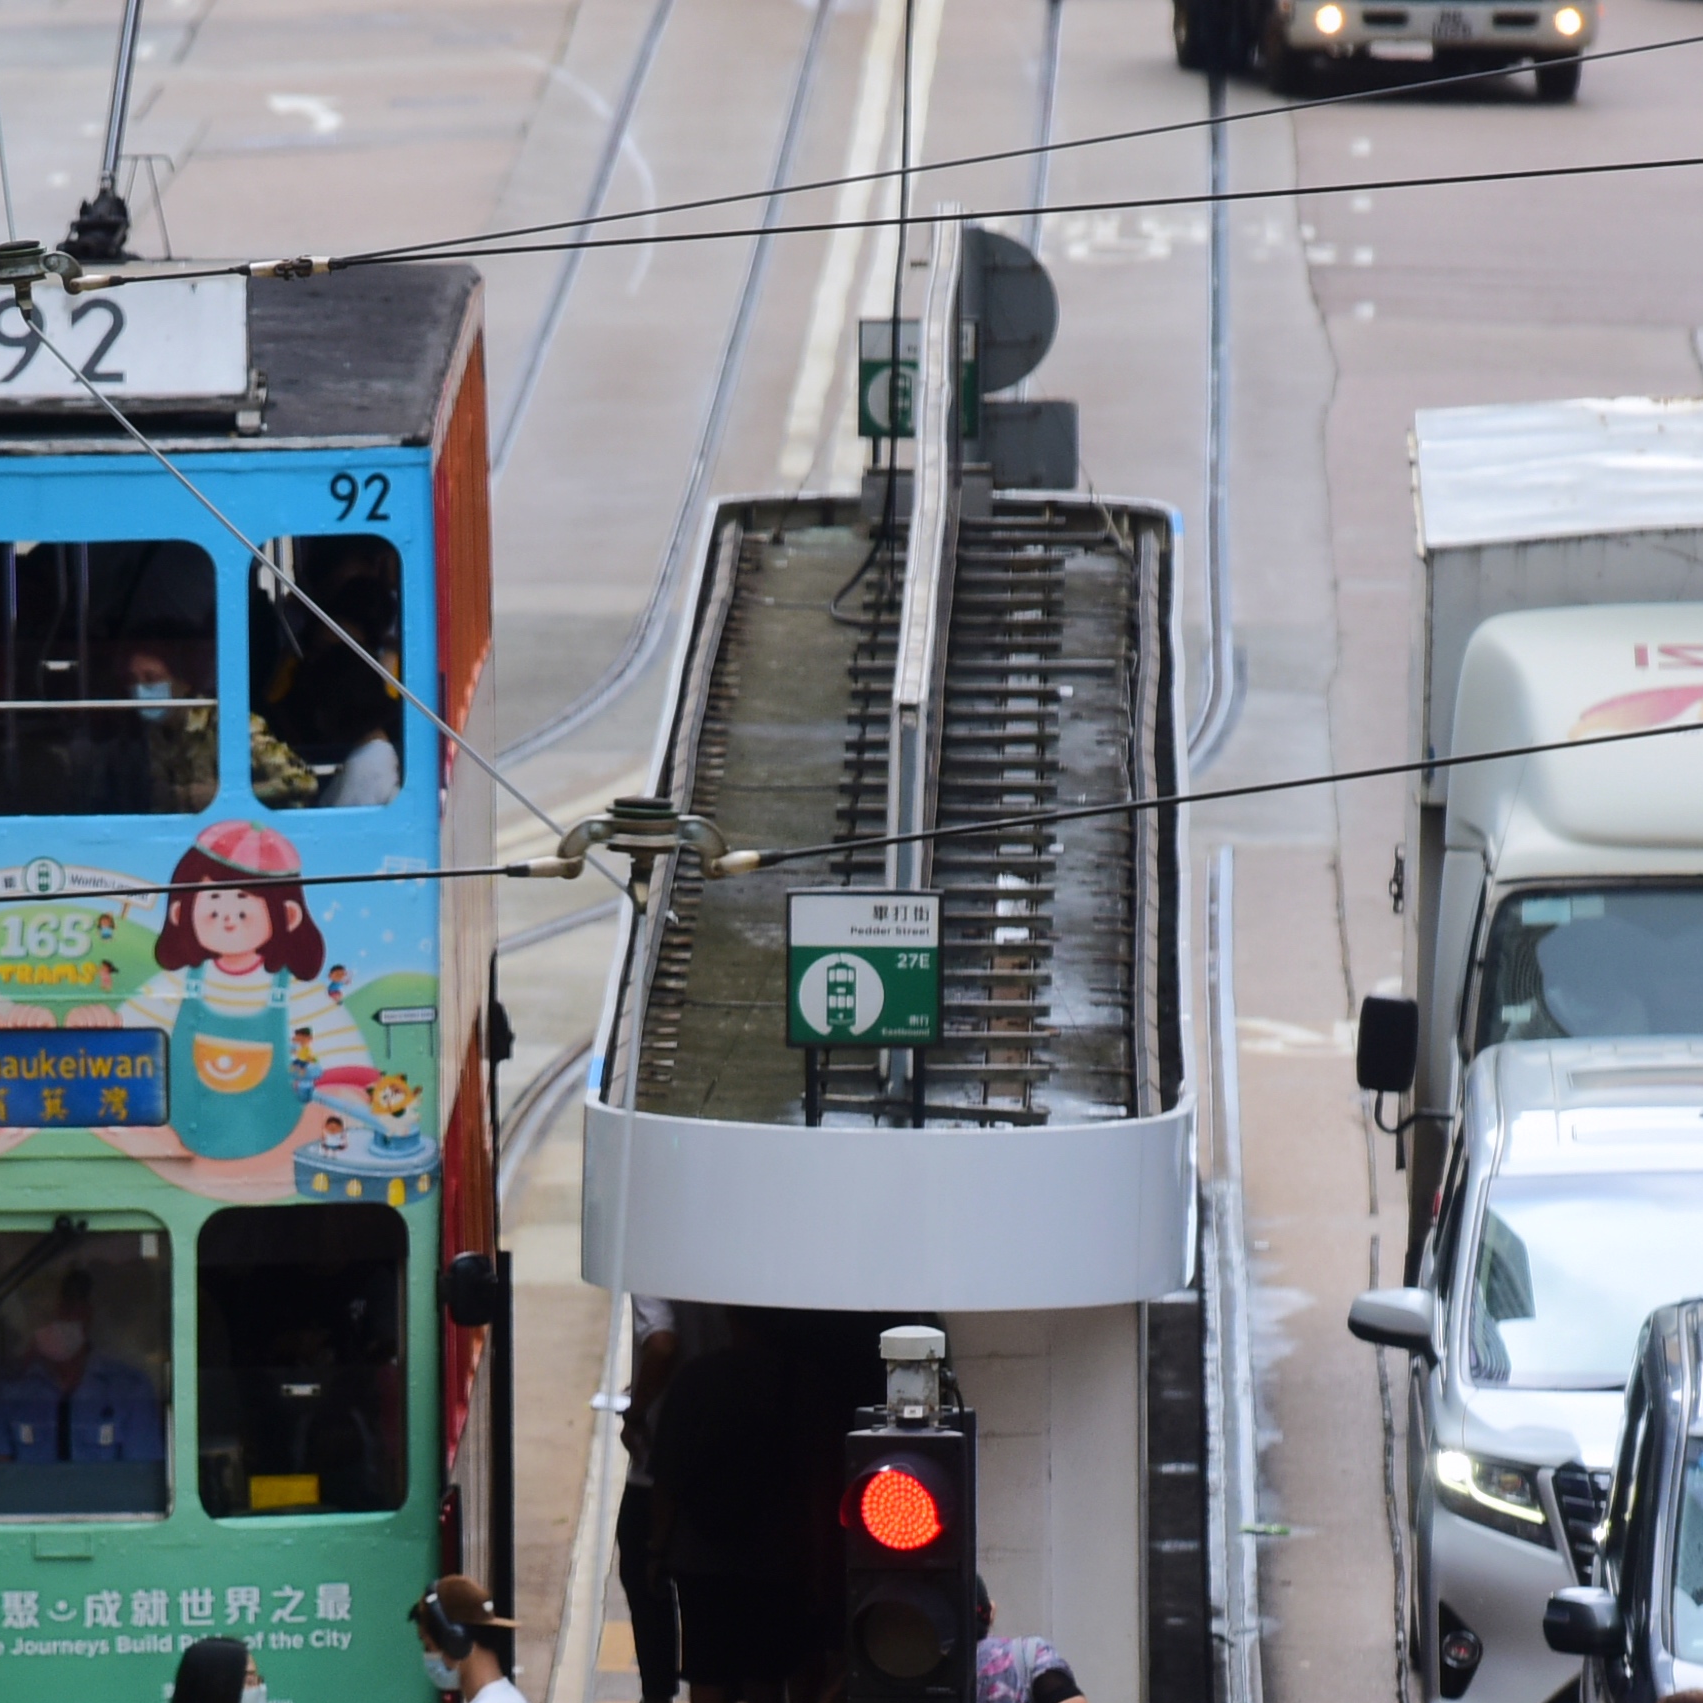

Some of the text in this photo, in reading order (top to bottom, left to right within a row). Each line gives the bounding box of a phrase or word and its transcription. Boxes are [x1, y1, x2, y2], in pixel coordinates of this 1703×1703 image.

[330, 473, 390, 520] 92
[0, 912, 95, 959] 165
[851, 926, 930, 935] Pedder Street
[897, 953, 930, 969] 27E
[83, 1583, 352, 1627] 成就世界之最
[11, 1634, 109, 1657] Journeys
[116, 1634, 173, 1653] Build
[243, 1631, 266, 1649] of
[268, 1631, 305, 1649] the
[309, 1629, 352, 1650] City
